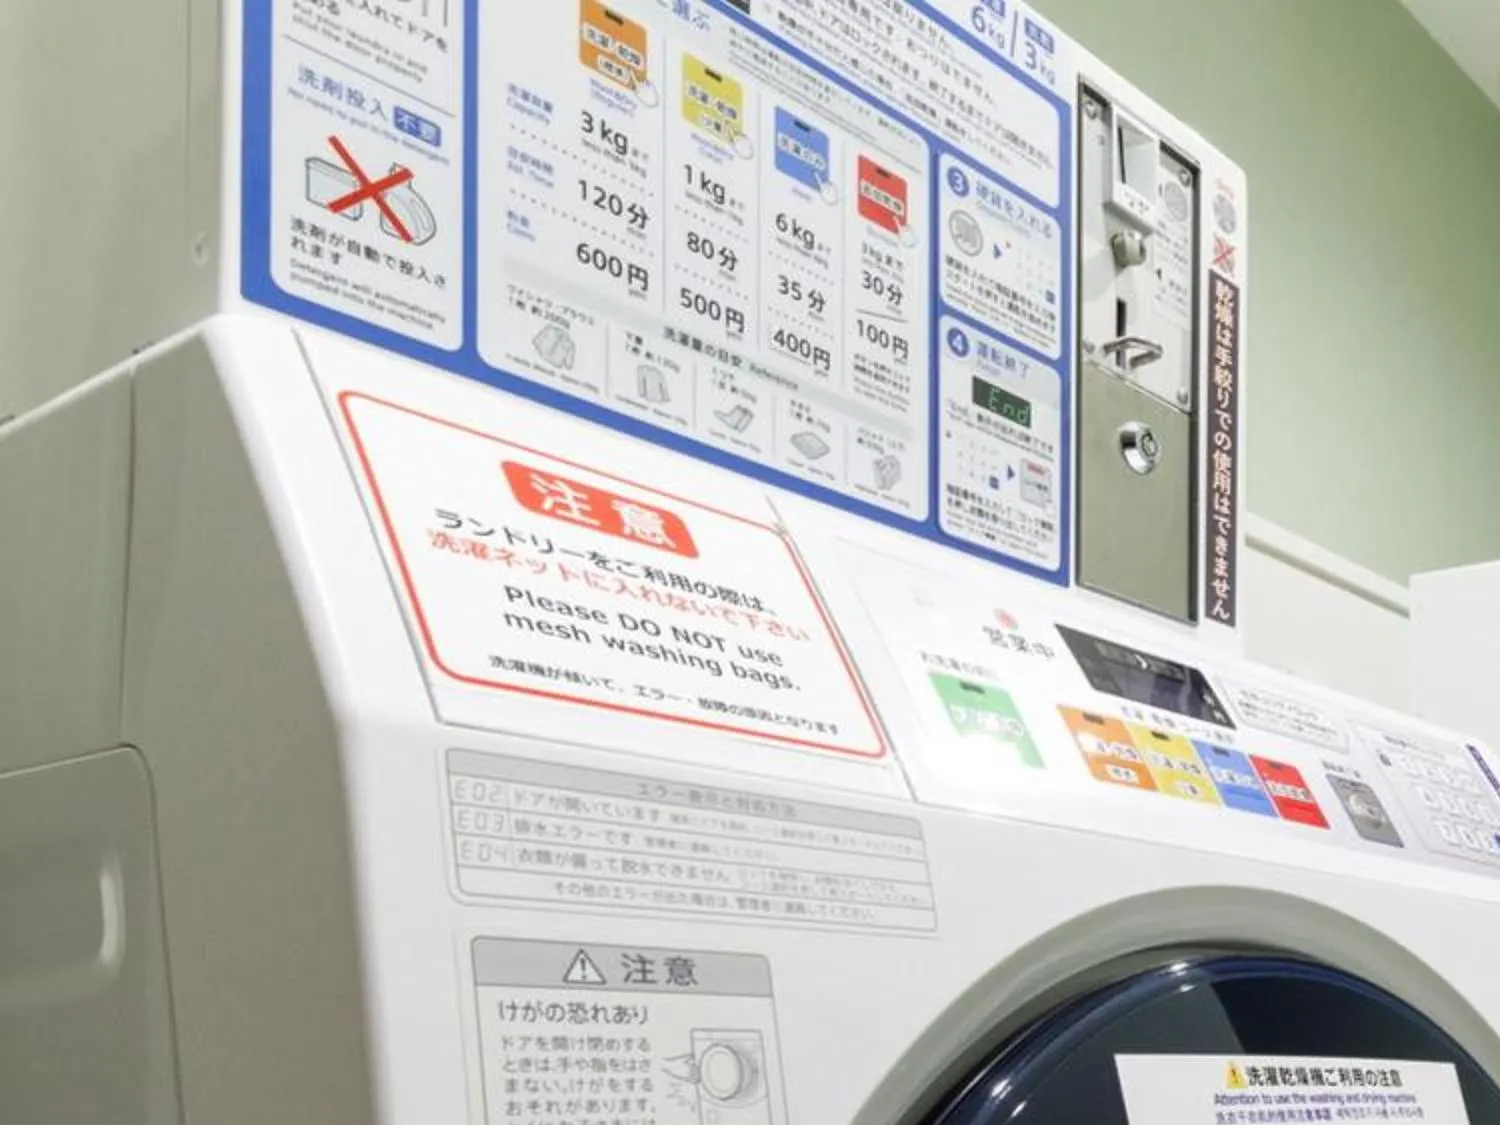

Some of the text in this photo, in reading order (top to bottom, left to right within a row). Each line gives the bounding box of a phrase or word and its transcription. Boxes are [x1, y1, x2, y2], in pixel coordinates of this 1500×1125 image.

[576, 238, 648, 293] 600円
[679, 285, 744, 336] 500円
[773, 325, 830, 372] 400円
[524, 470, 678, 550] 注意
[499, 607, 803, 695] mesh washing bags.
[502, 583, 785, 668] Please DO NOT use
[619, 952, 699, 987] 注意
[498, 1001, 649, 1025] けがの恐れあり
[1244, 1065, 1404, 1088] 洗濯乾燥機ご利用の注意
